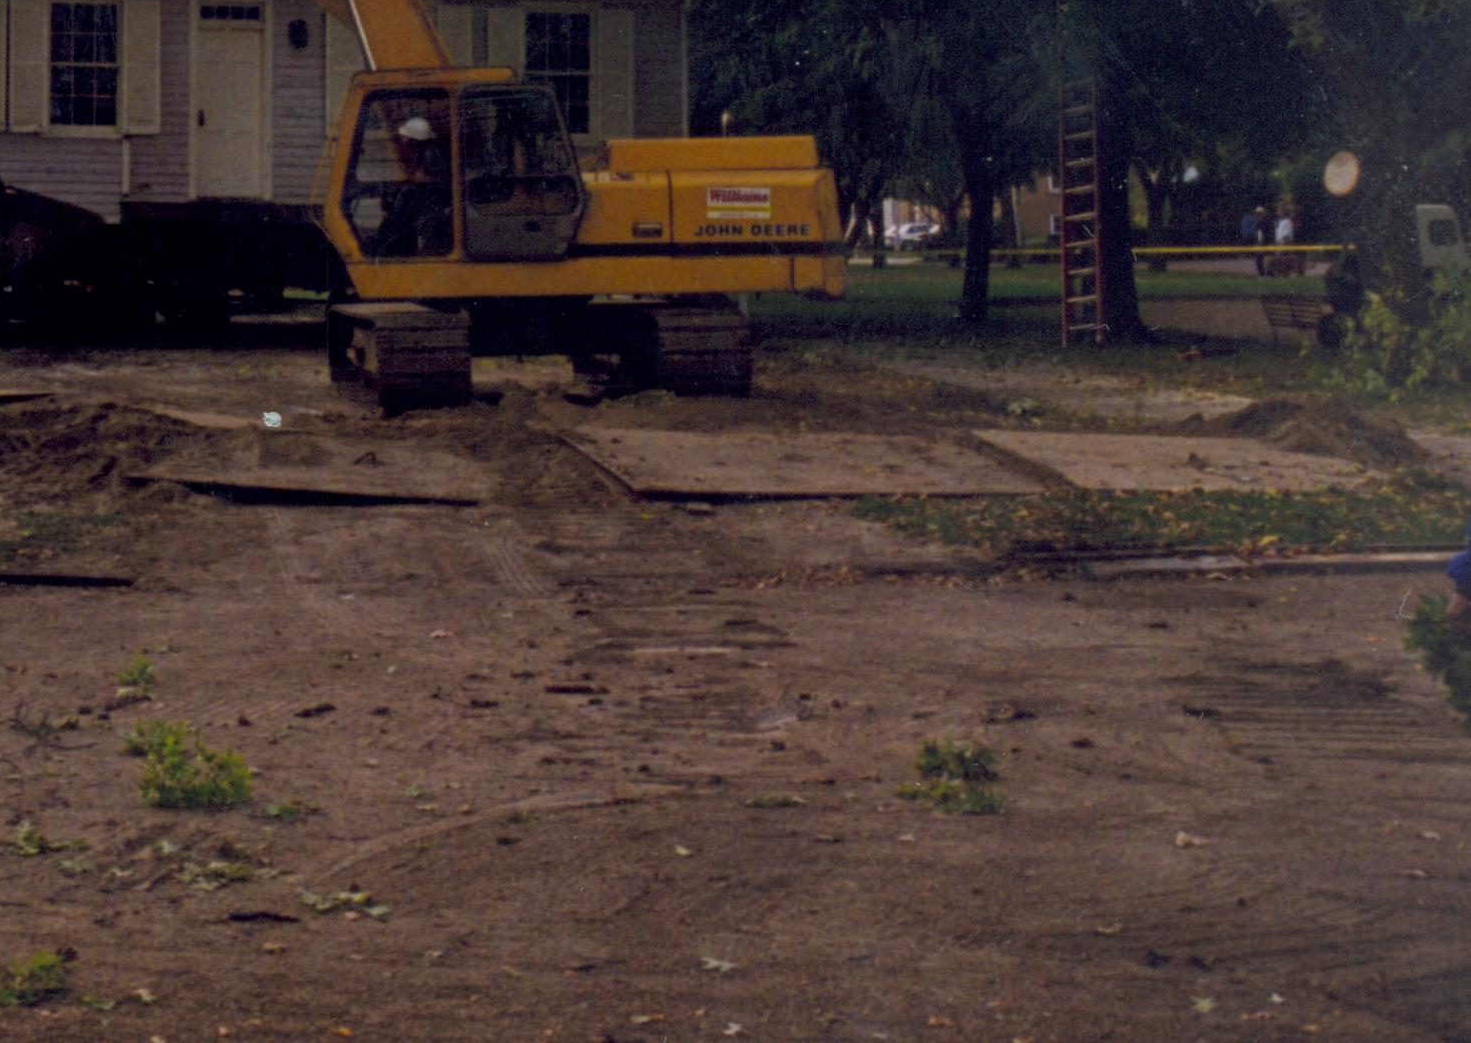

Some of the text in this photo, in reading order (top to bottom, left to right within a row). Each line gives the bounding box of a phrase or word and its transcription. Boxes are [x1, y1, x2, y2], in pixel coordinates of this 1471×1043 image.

[710, 189, 769, 203] Williams
[695, 224, 810, 236] JOHN DEERE
